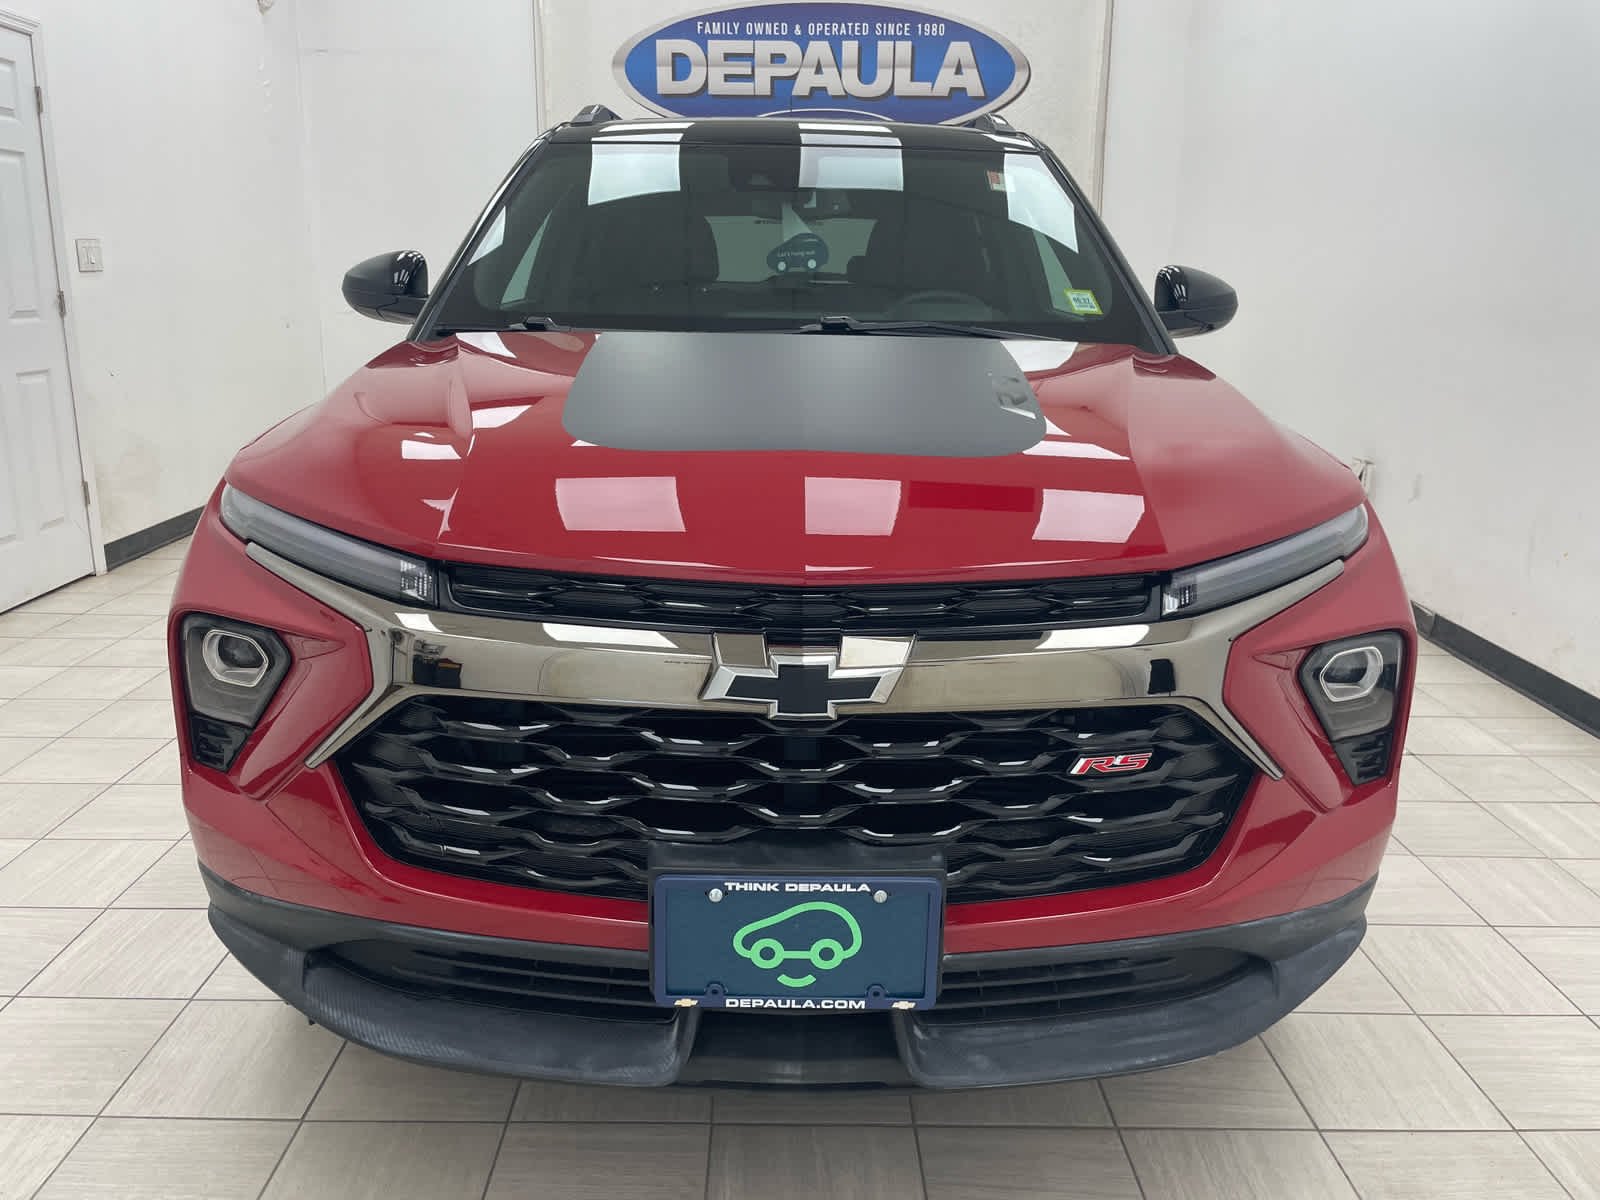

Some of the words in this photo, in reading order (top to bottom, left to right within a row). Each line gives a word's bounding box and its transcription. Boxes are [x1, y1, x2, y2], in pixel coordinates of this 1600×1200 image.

[696, 21, 740, 35] FAMILY
[746, 22, 788, 35] OWNED
[794, 24, 802, 35] &
[808, 22, 869, 36] OPERATED
[875, 23, 911, 36] SINCE
[917, 23, 945, 36] 1980
[655, 39, 985, 98] DEPAULA
[1070, 752, 1153, 775] RS
[724, 882, 779, 892] THINK
[785, 883, 871, 893] DEPAULA
[725, 999, 866, 1010] DEPAULA.COM
